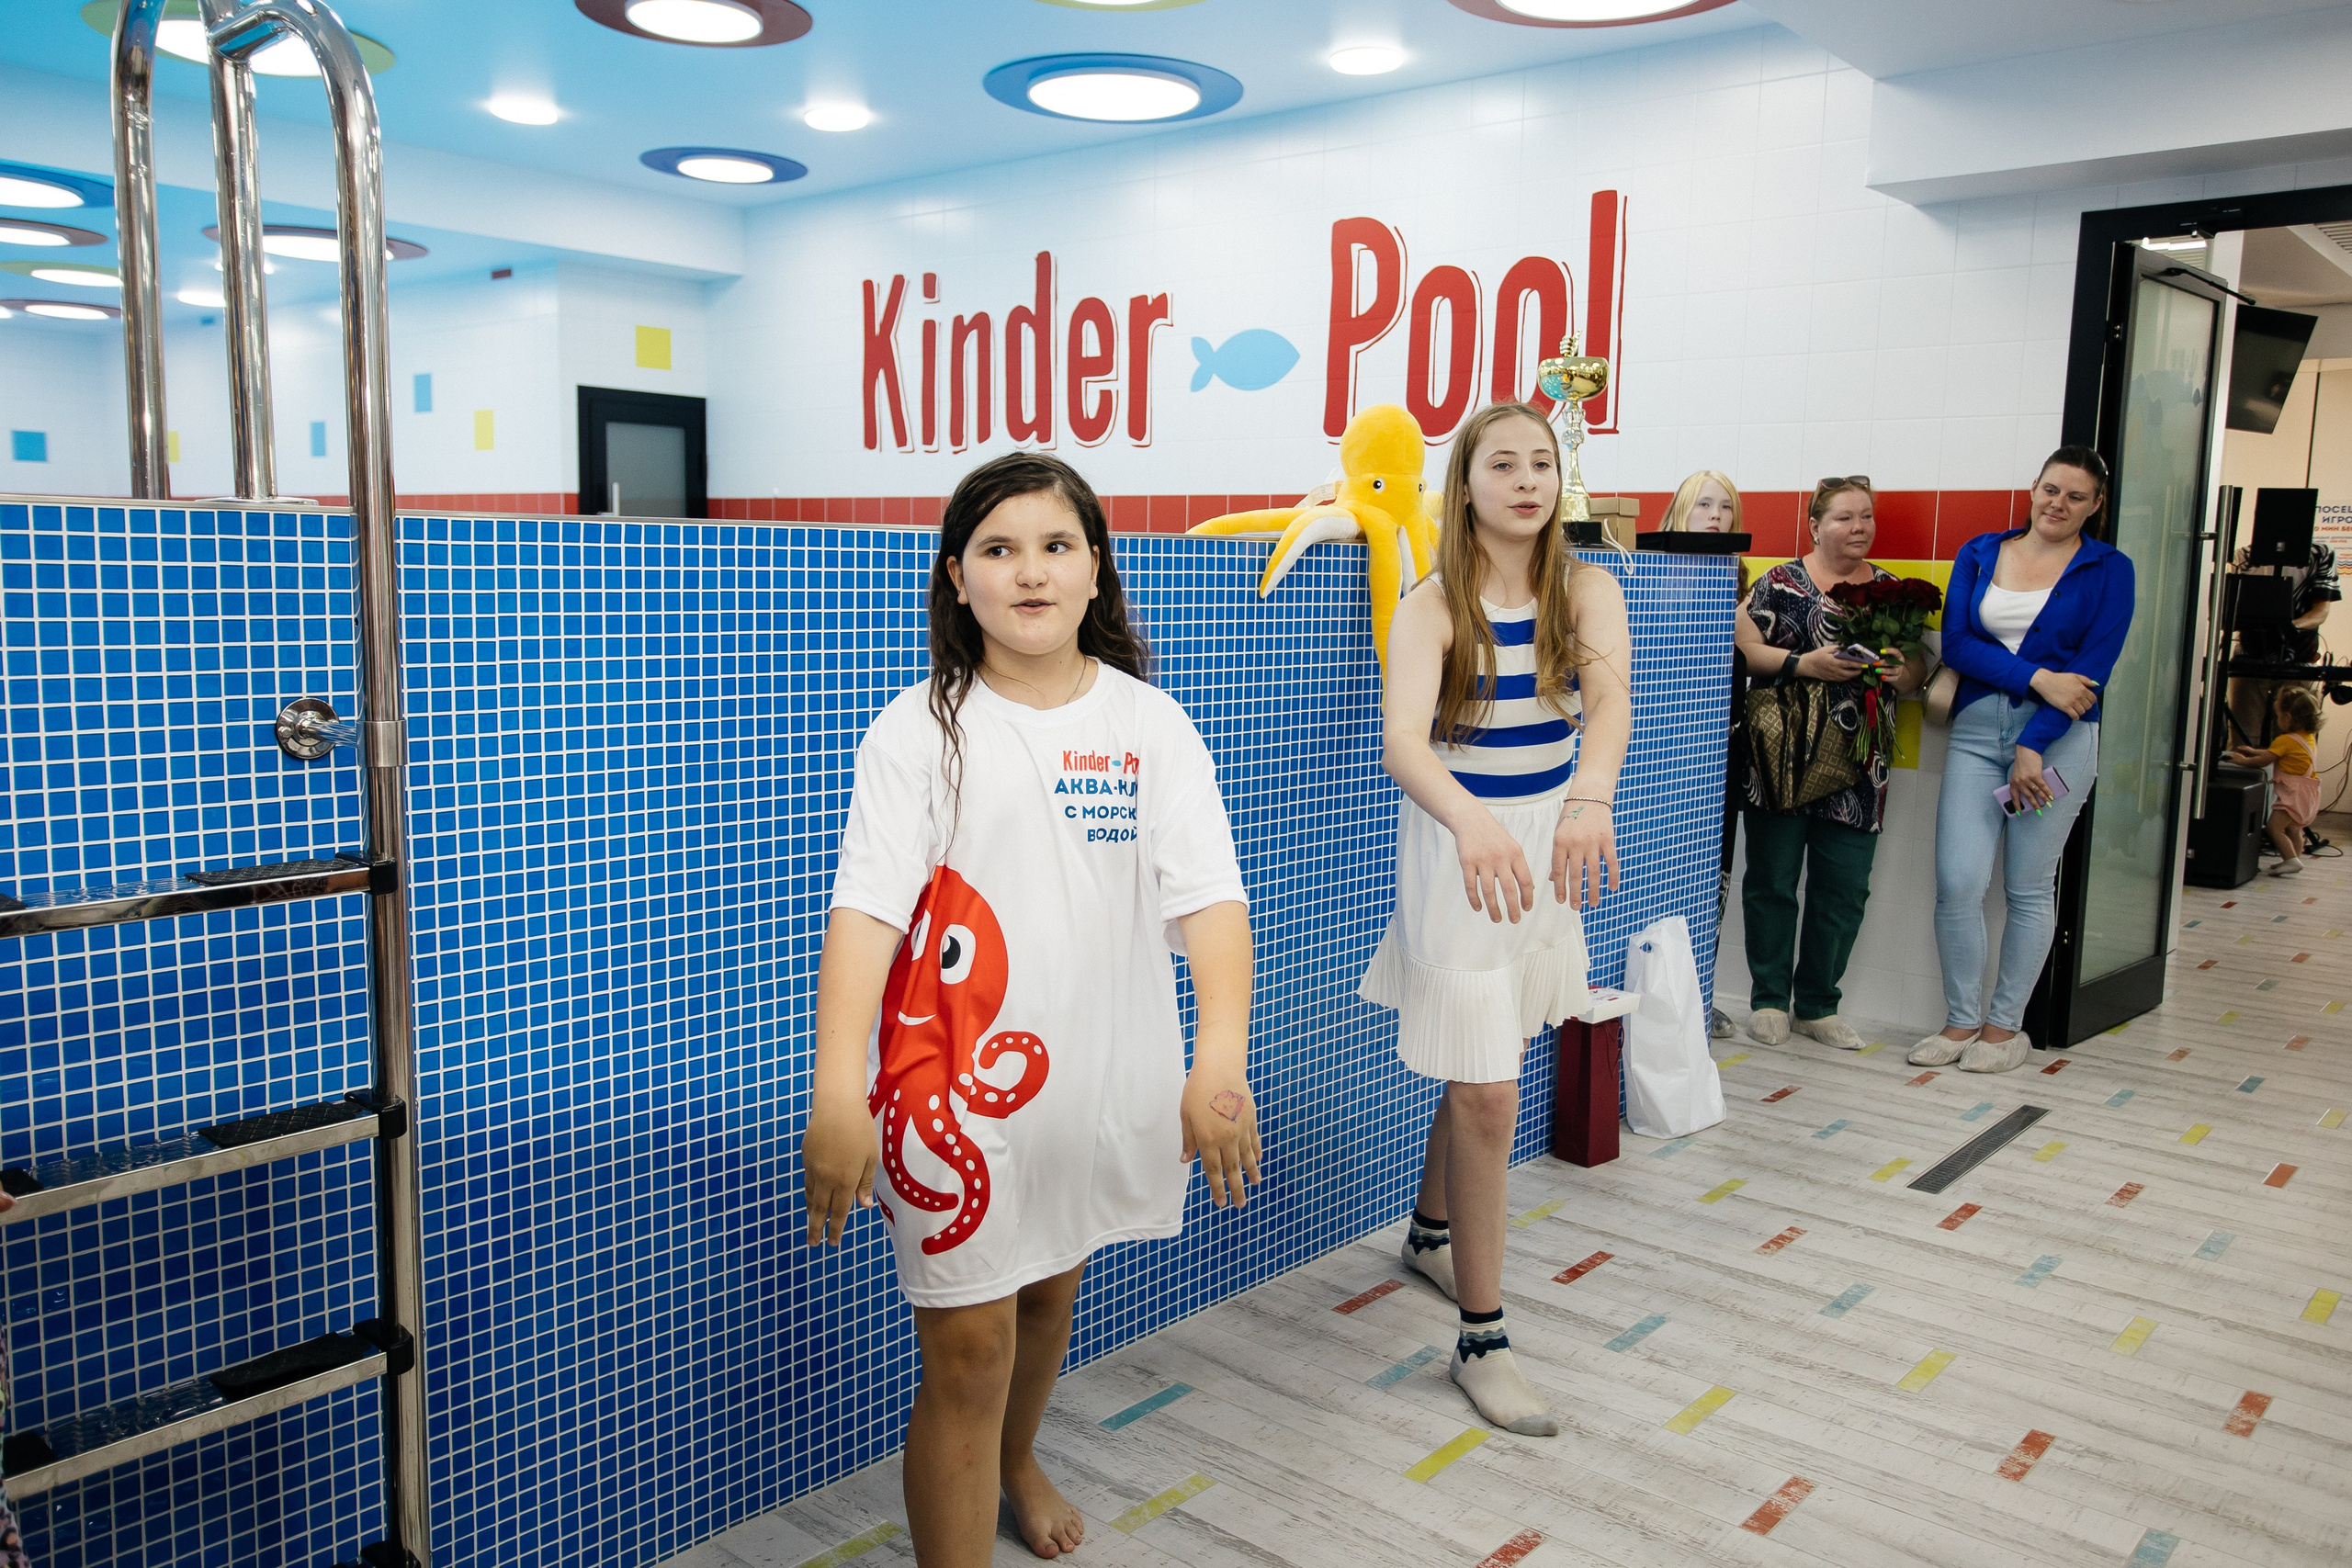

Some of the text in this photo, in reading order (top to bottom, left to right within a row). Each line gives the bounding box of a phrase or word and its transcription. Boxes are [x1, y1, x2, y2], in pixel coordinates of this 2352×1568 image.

[863, 190, 1627, 454] Kinder Pool
[1062, 750, 1139, 774] Kinder Po
[1065, 806, 1077, 818] С
